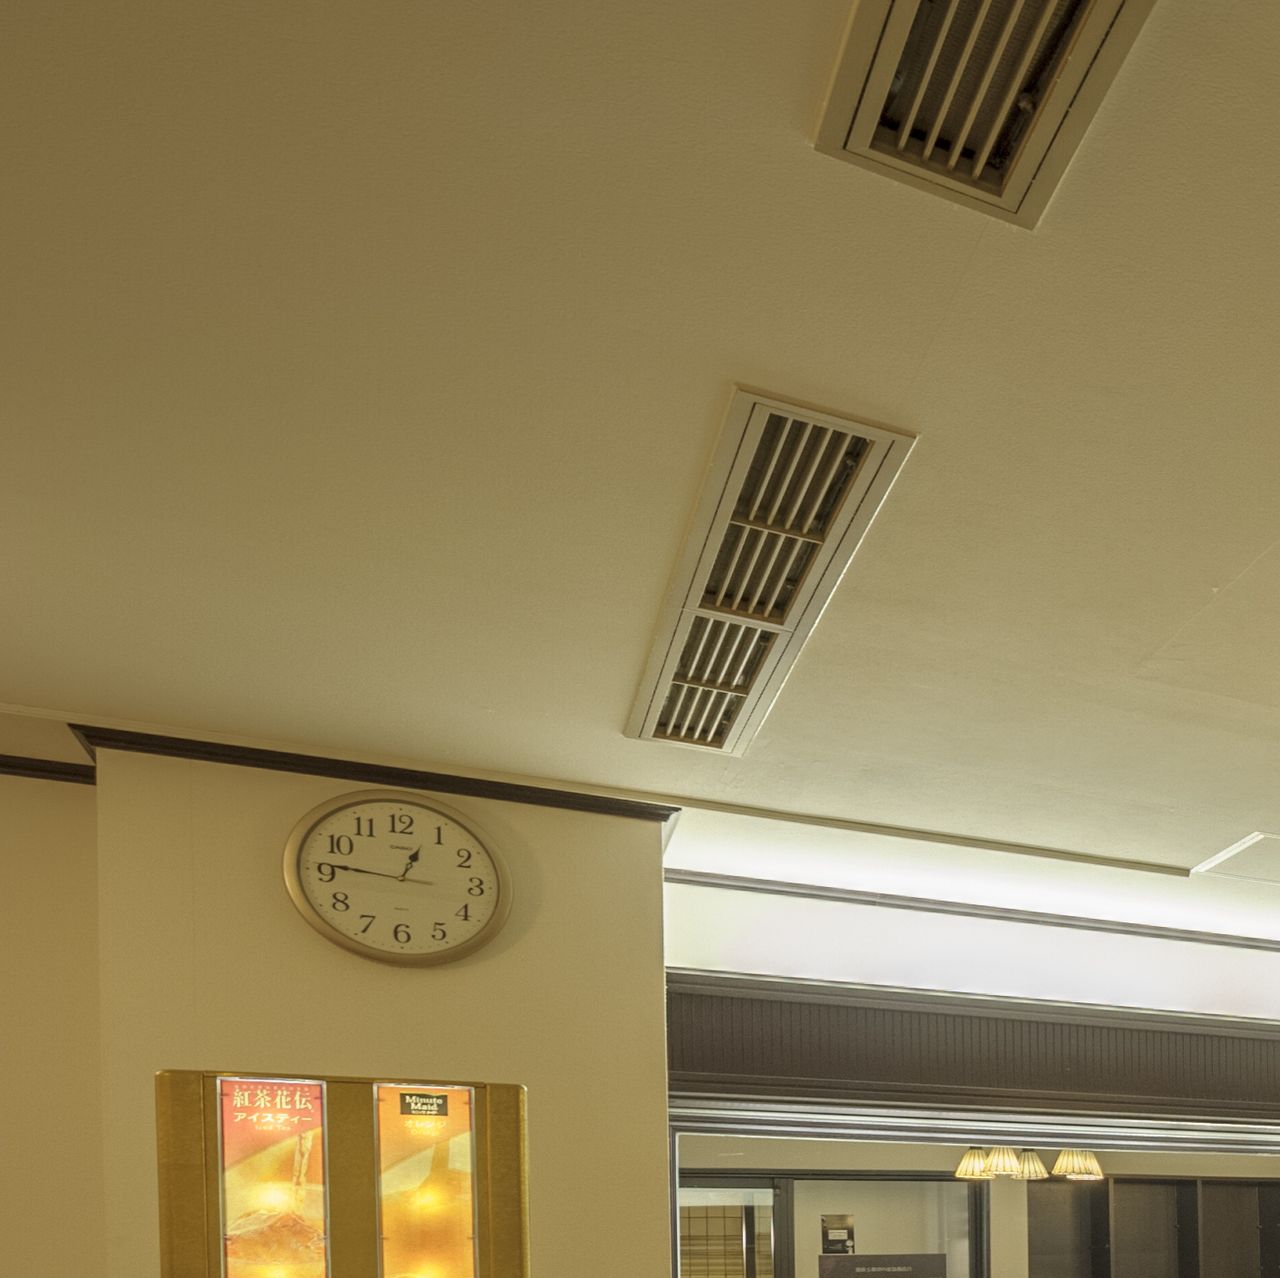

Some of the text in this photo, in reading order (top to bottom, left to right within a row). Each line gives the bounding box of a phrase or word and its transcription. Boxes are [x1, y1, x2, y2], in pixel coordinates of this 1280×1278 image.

[354, 816, 376, 837] 11
[388, 814, 414, 835] 12
[328, 834, 354, 856] 10
[434, 826, 444, 846] 1
[457, 848, 472, 869] 2
[317, 862, 337, 883] 9
[467, 877, 485, 897] 3
[332, 891, 350, 912] 8
[454, 903, 472, 922] 4
[360, 914, 376, 934] 7
[393, 923, 411, 944] 6
[431, 922, 447, 941] 5
[233, 1089, 313, 1110] 紅茶花伝
[405, 1095, 443, 1105] Minute
[410, 1103, 439, 1111] Maid
[233, 1112, 313, 1124] アイスティー
